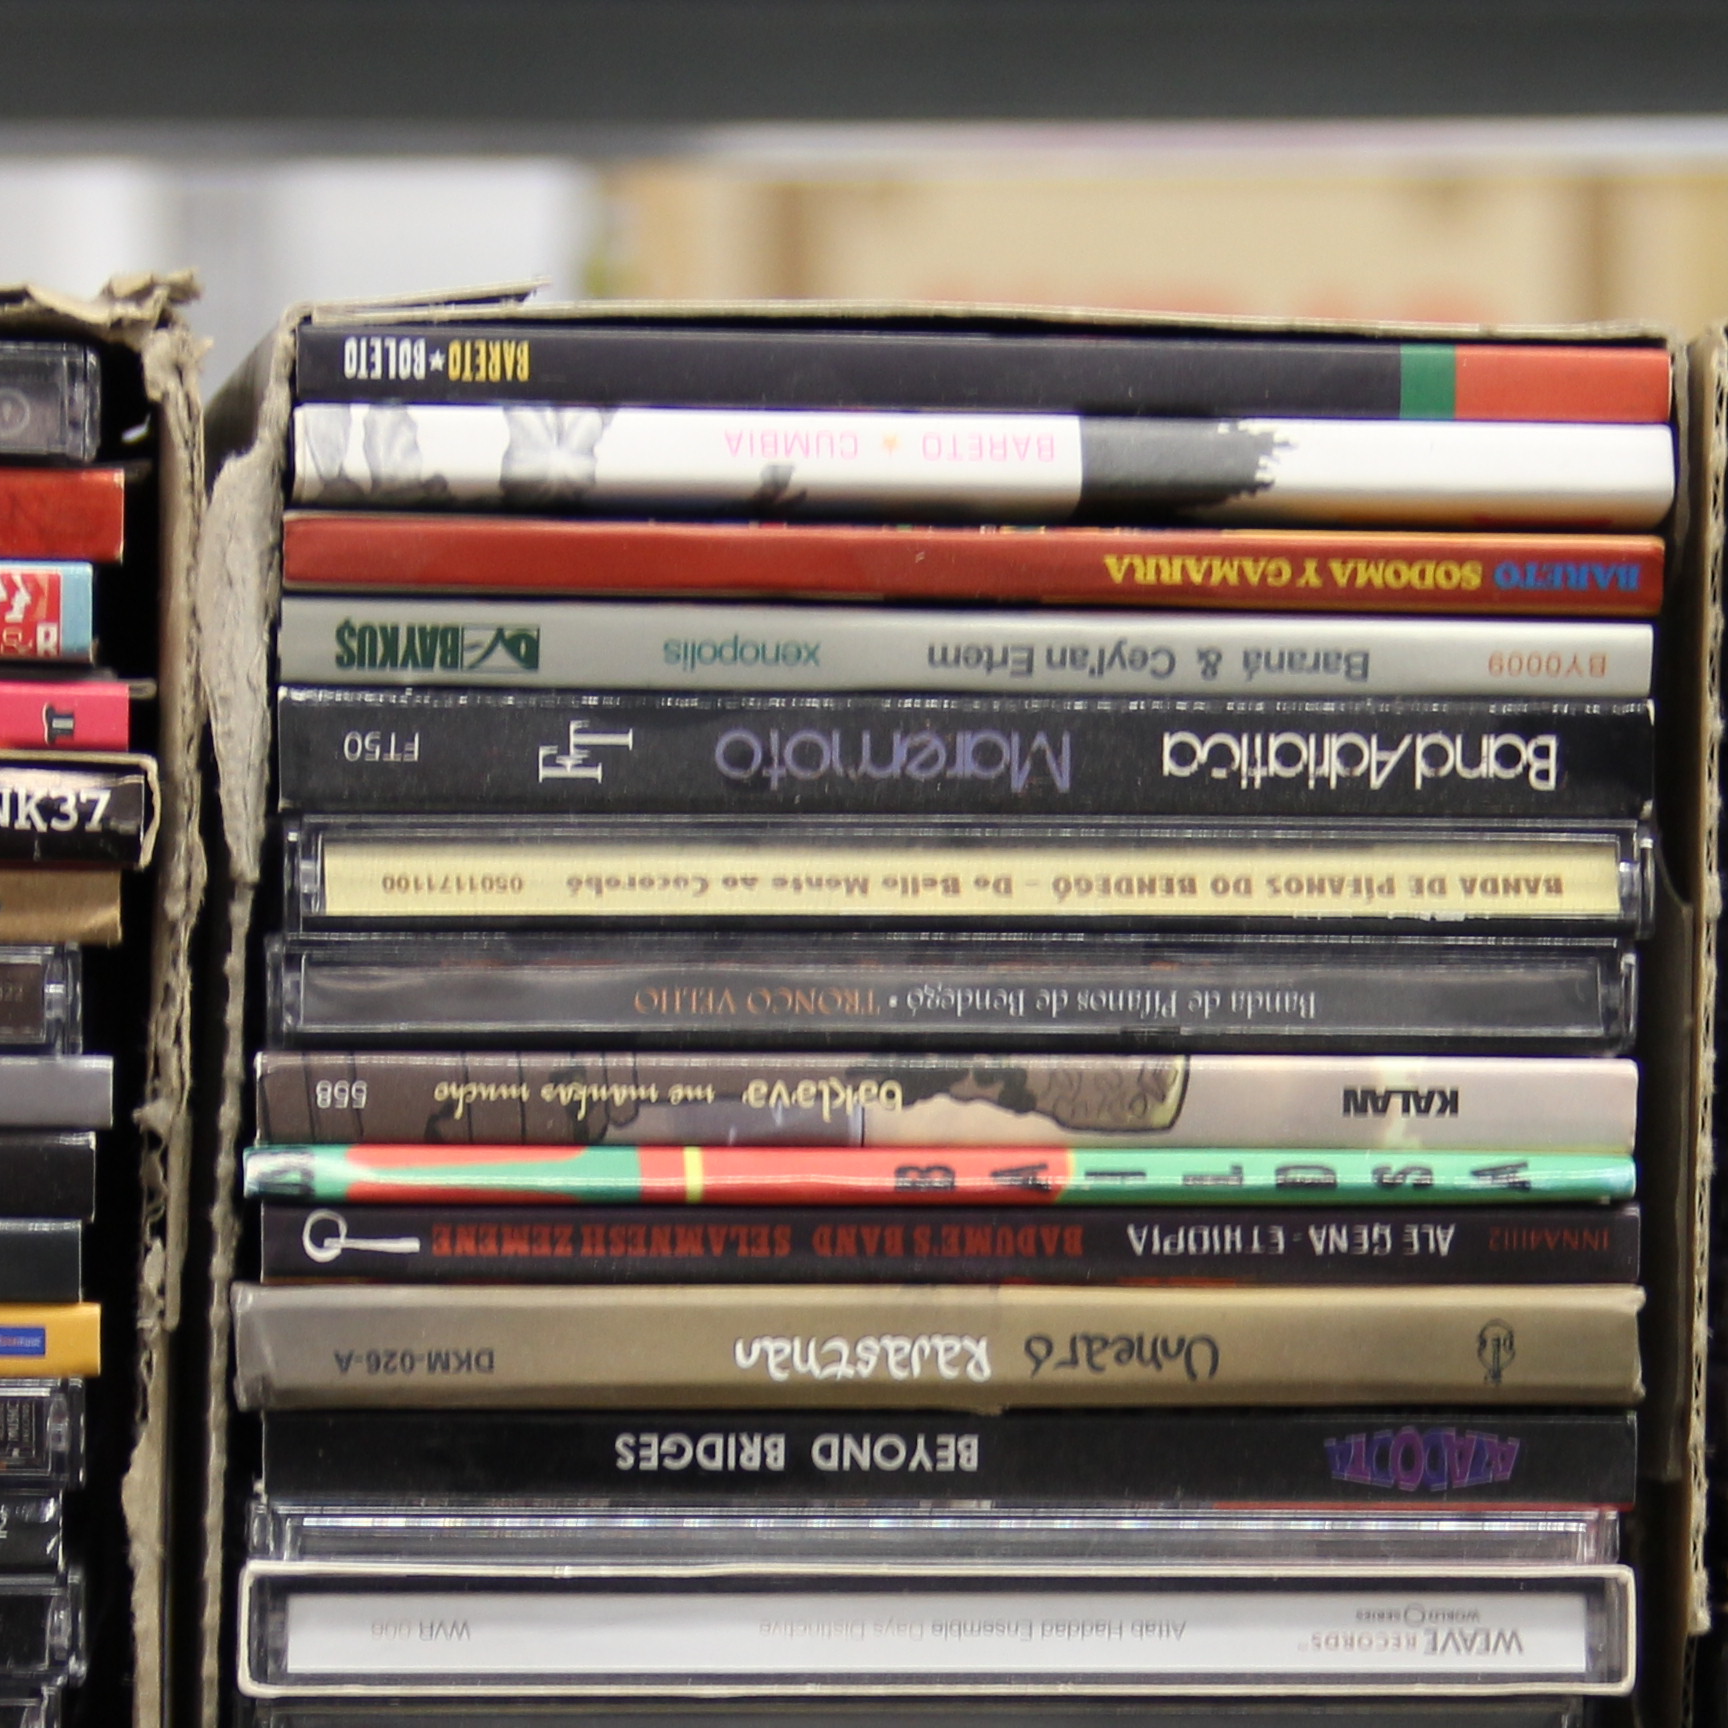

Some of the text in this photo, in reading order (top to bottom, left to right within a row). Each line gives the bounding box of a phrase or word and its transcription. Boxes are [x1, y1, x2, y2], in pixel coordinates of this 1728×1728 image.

[344, 338, 529, 381] BARETO BOLETO
[1104, 555, 1640, 590] BARETO SODOMA Y GAMARRA
[662, 632, 820, 670] xenopolis
[927, 645, 1034, 675] Ertem
[1196, 649, 1222, 676] &
[1242, 649, 1369, 682] Baraná
[344, 731, 420, 761] FT50
[714, 729, 1072, 792] Maremoto
[315, 1080, 367, 1108] 558
[1342, 1088, 1458, 1117] KALAN
[333, 1348, 495, 1374] DKM-026-A
[614, 1435, 978, 1471] BEYOND BRIDGES
